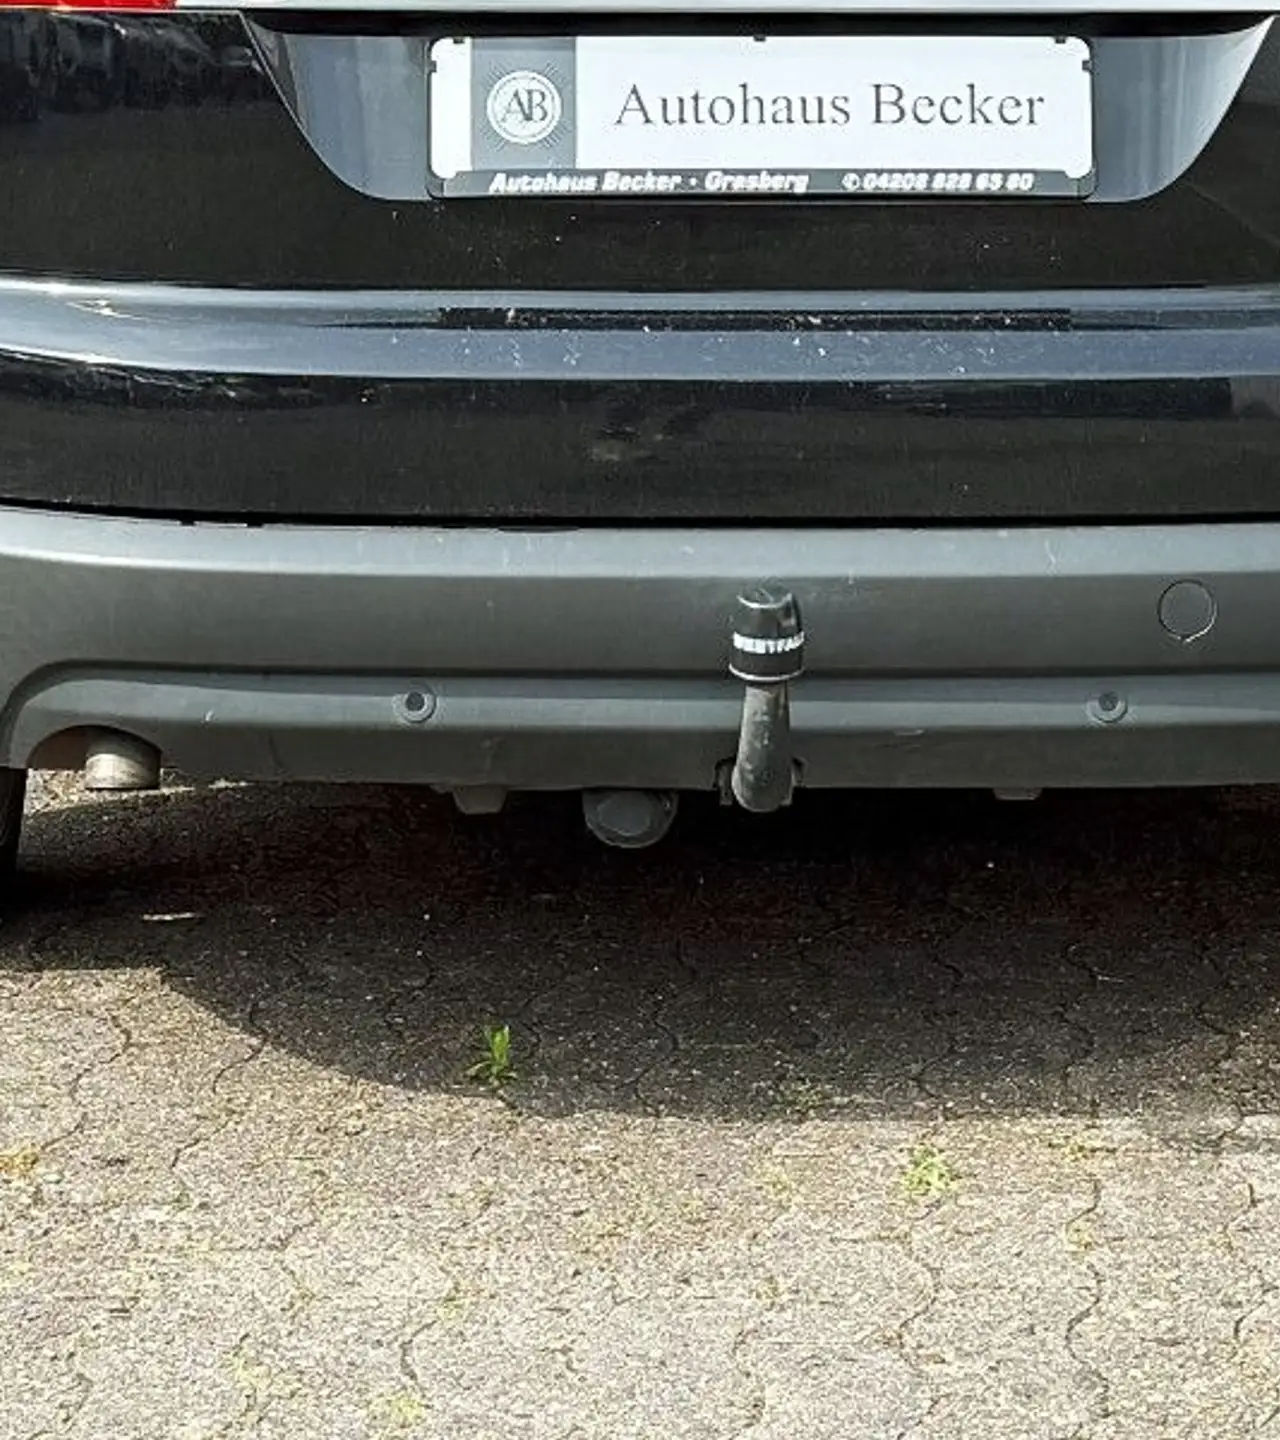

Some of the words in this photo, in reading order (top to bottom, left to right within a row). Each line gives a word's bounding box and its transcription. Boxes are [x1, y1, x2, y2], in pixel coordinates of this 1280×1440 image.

[501, 89, 549, 123] AB
[615, 82, 851, 126] Autohaus
[872, 82, 1045, 126] Becker
[488, 171, 598, 194] Autohaus
[601, 170, 682, 192] Becker
